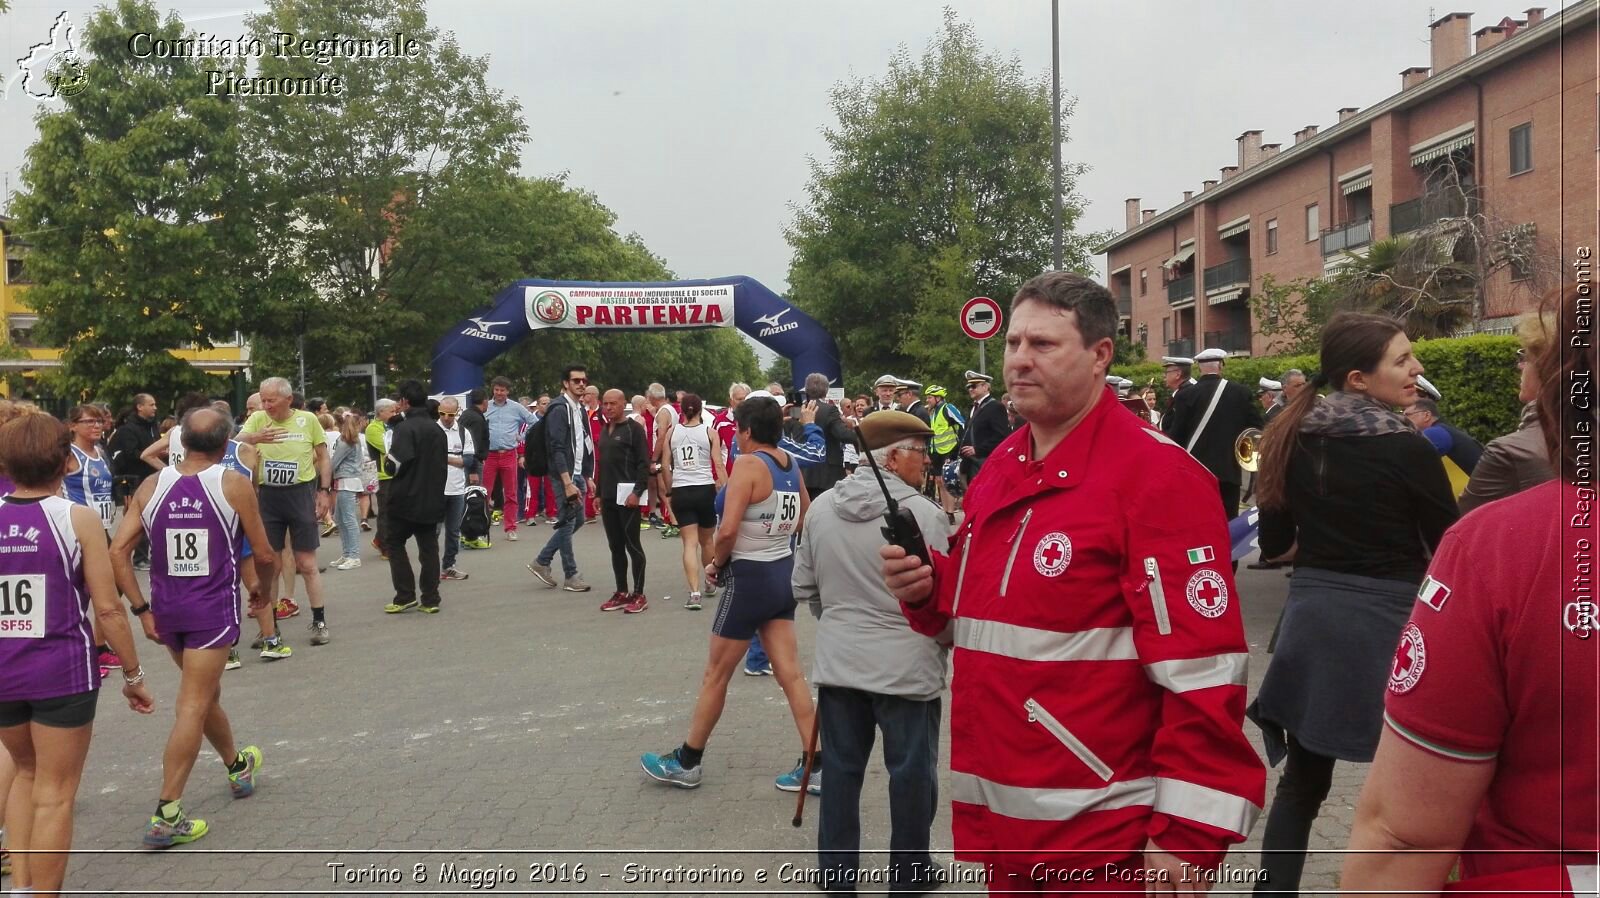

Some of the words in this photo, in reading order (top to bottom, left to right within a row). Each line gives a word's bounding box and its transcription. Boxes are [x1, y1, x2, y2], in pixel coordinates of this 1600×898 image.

[569, 290, 613, 298] CAMPIONATO
[613, 290, 644, 298] ITALIANO
[644, 290, 685, 298] INDIVIDUALE
[686, 289, 691, 297] E
[692, 289, 700, 297] DI
[700, 288, 728, 297] SOCIETÀ
[601, 297, 627, 305] MASTER
[628, 297, 636, 305] DI
[636, 297, 660, 305] CORSA
[670, 296, 697, 304] STRADA
[575, 304, 724, 325] PARTENZA
[681, 445, 694, 460] 12
[266, 469, 295, 484] 1202
[168, 497, 203, 512] P.B.M.
[781, 494, 796, 521] 56
[173, 532, 198, 560] 18
[174, 563, 200, 572] SM65
[0, 579, 33, 615] 16
[0, 620, 33, 631] SF55
[1404, 655, 1424, 688] AGOSTO
